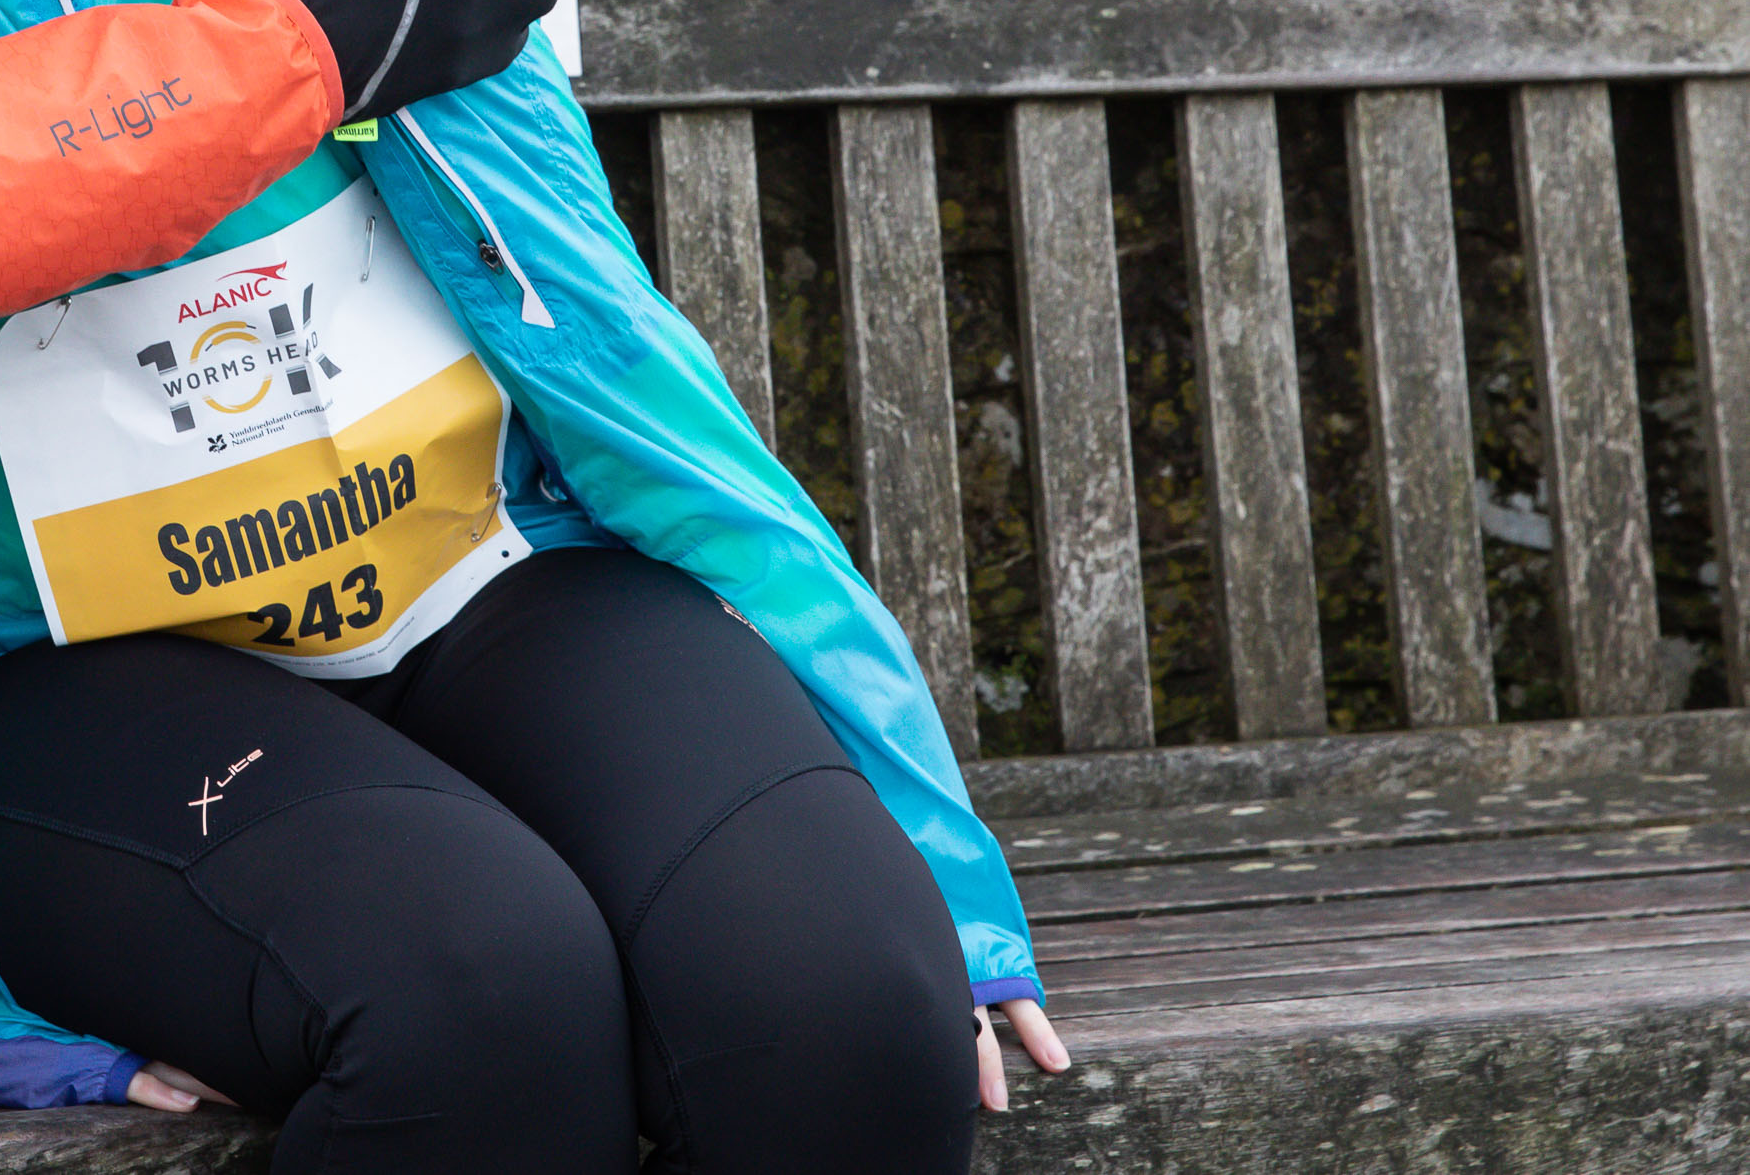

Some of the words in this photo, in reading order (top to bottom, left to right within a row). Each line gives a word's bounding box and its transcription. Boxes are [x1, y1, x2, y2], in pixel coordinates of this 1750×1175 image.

[50, 77, 193, 158] R-Light
[178, 277, 272, 324] ALANIC
[162, 355, 256, 398] WORMS
[231, 431, 265, 447] National
[266, 424, 285, 436] Trust
[157, 453, 418, 596] Samantha
[246, 563, 385, 647] 243
